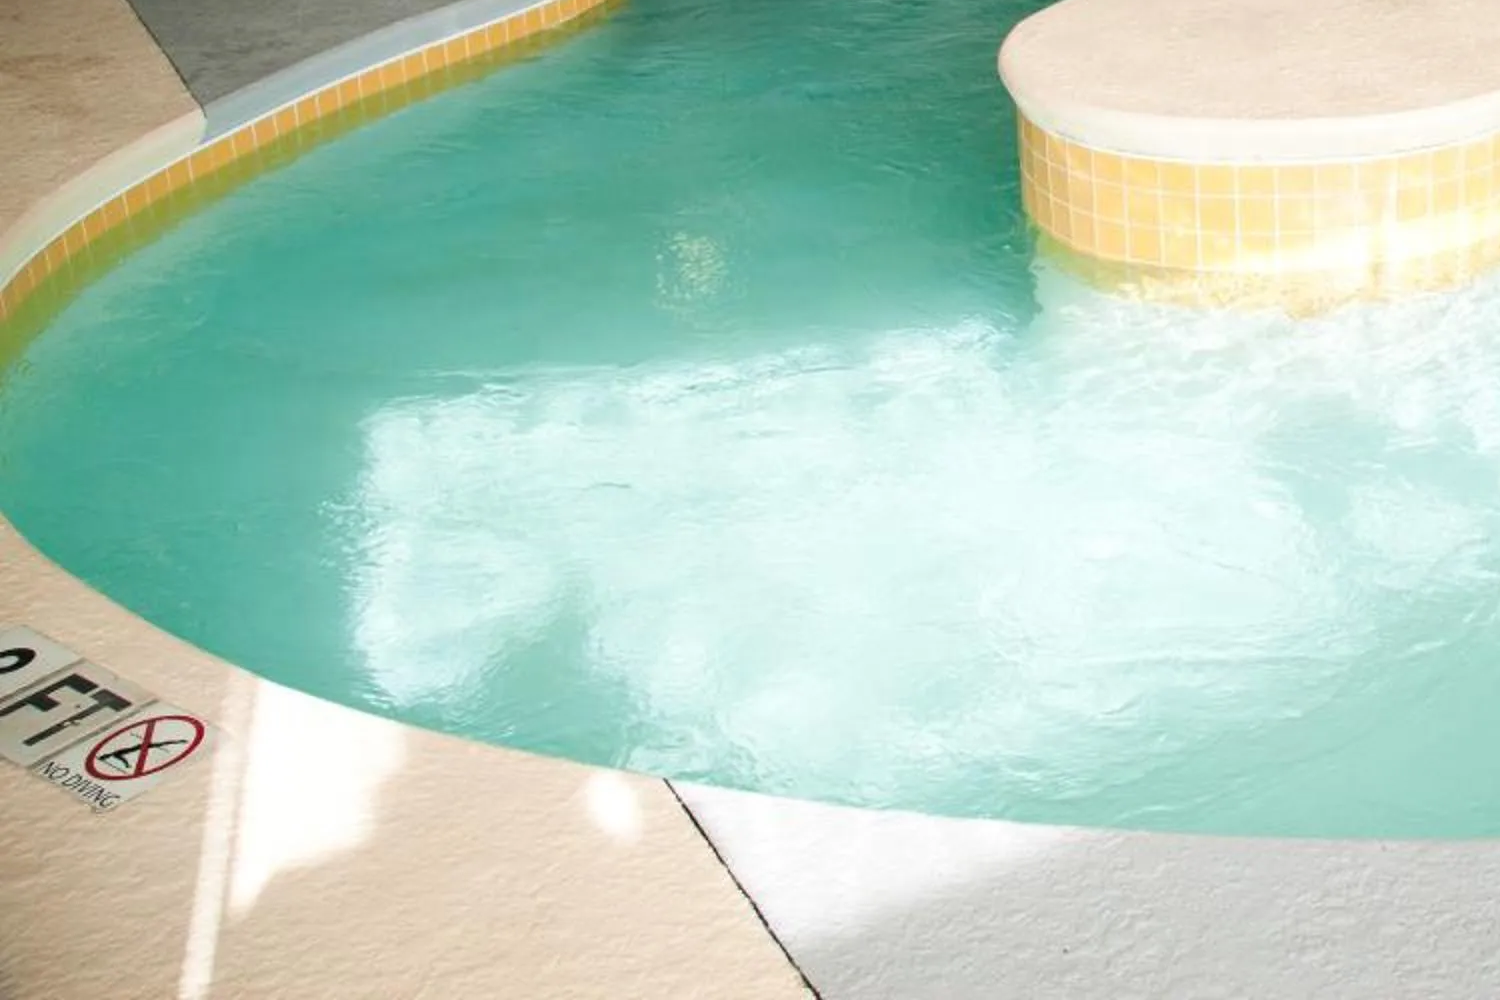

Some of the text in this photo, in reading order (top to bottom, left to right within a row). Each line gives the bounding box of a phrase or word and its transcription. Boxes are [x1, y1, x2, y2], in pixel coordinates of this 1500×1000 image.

[0, 673, 132, 747] FT
[40, 761, 121, 809] NO DIVING
